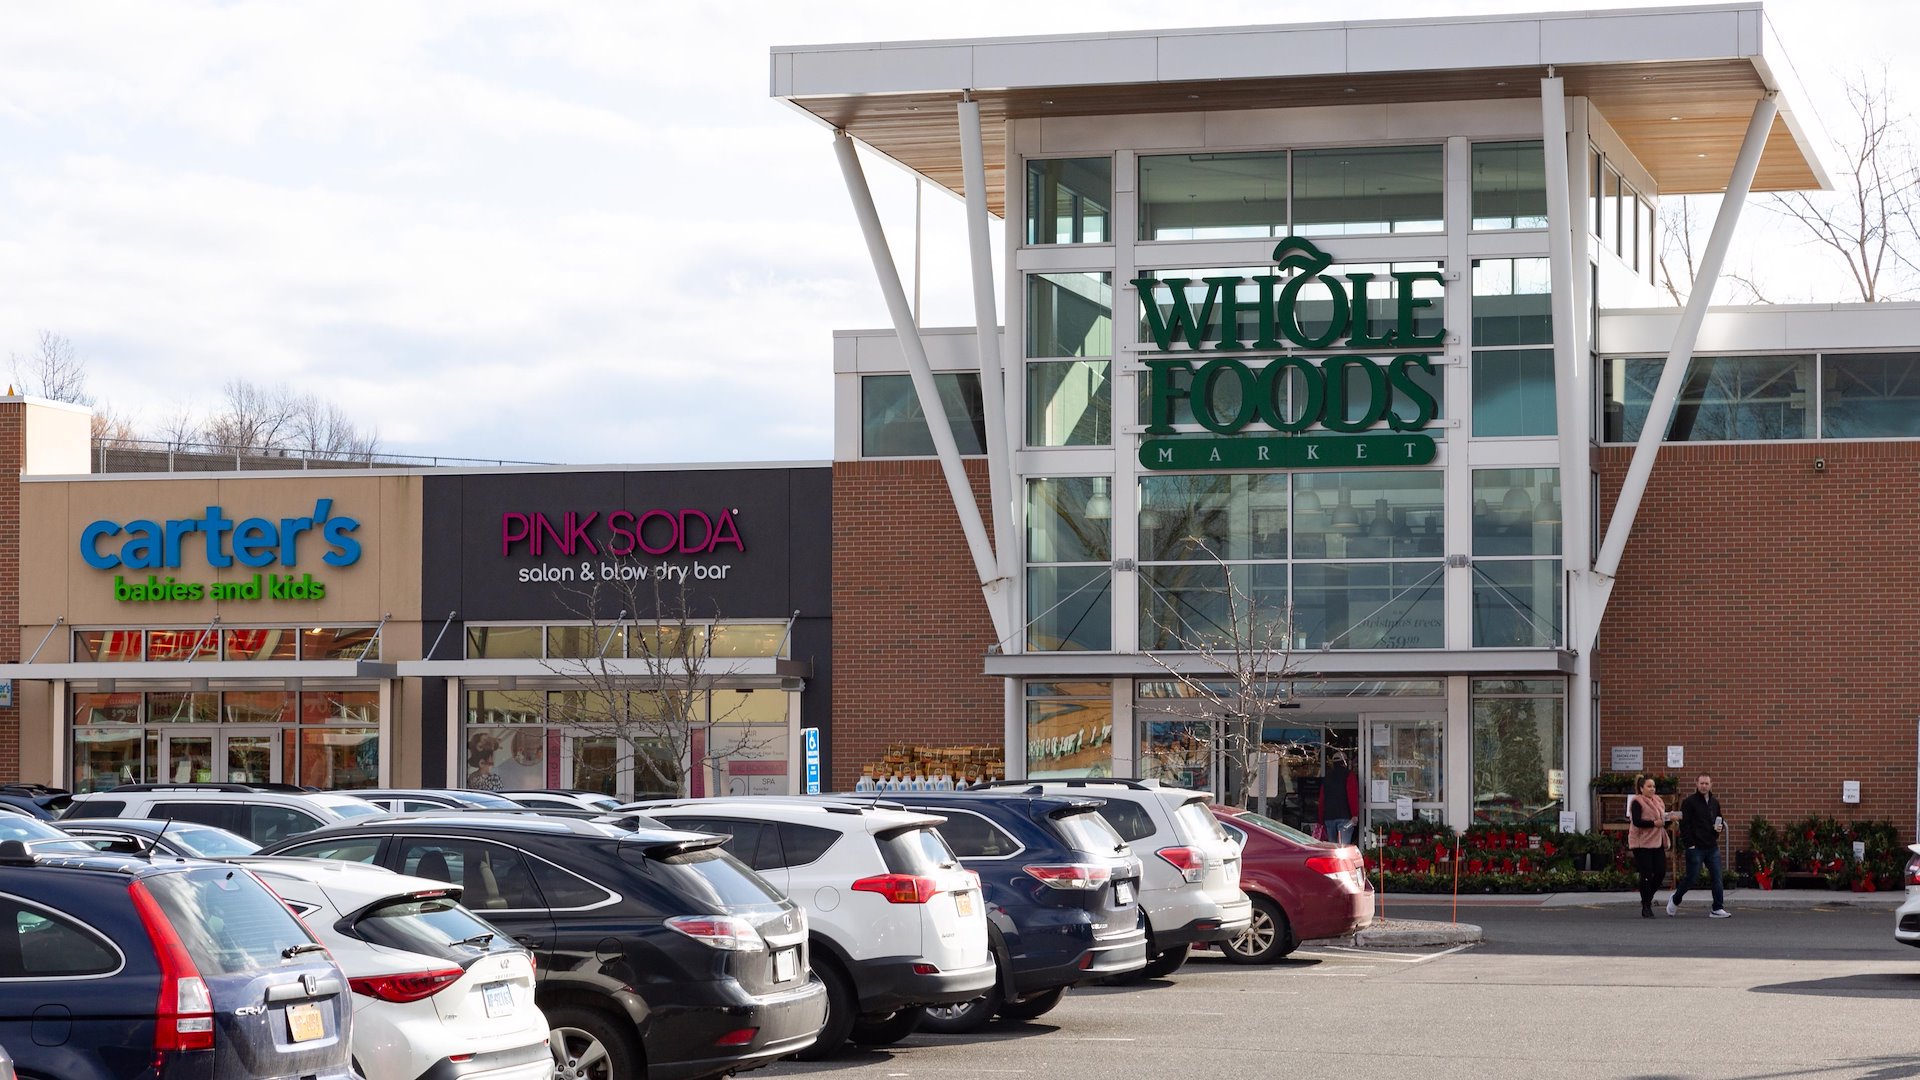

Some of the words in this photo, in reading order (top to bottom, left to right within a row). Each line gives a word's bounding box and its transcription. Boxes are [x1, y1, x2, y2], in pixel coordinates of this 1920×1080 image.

[1130, 268, 1448, 350] WHOLE
[1144, 353, 1438, 435] FOODS
[1158, 442, 1417, 462] MARKET
[79, 497, 362, 570] carter's
[502, 510, 600, 557] PINK
[606, 507, 746, 556] SODA
[113, 575, 204, 601] babies
[209, 573, 262, 601] and
[268, 573, 326, 600] kids
[518, 563, 575, 582] salon
[579, 562, 595, 581] &
[600, 562, 648, 581] blow
[655, 561, 689, 585] dry
[693, 561, 731, 580] bar
[234, 1004, 267, 1016] CR-V
